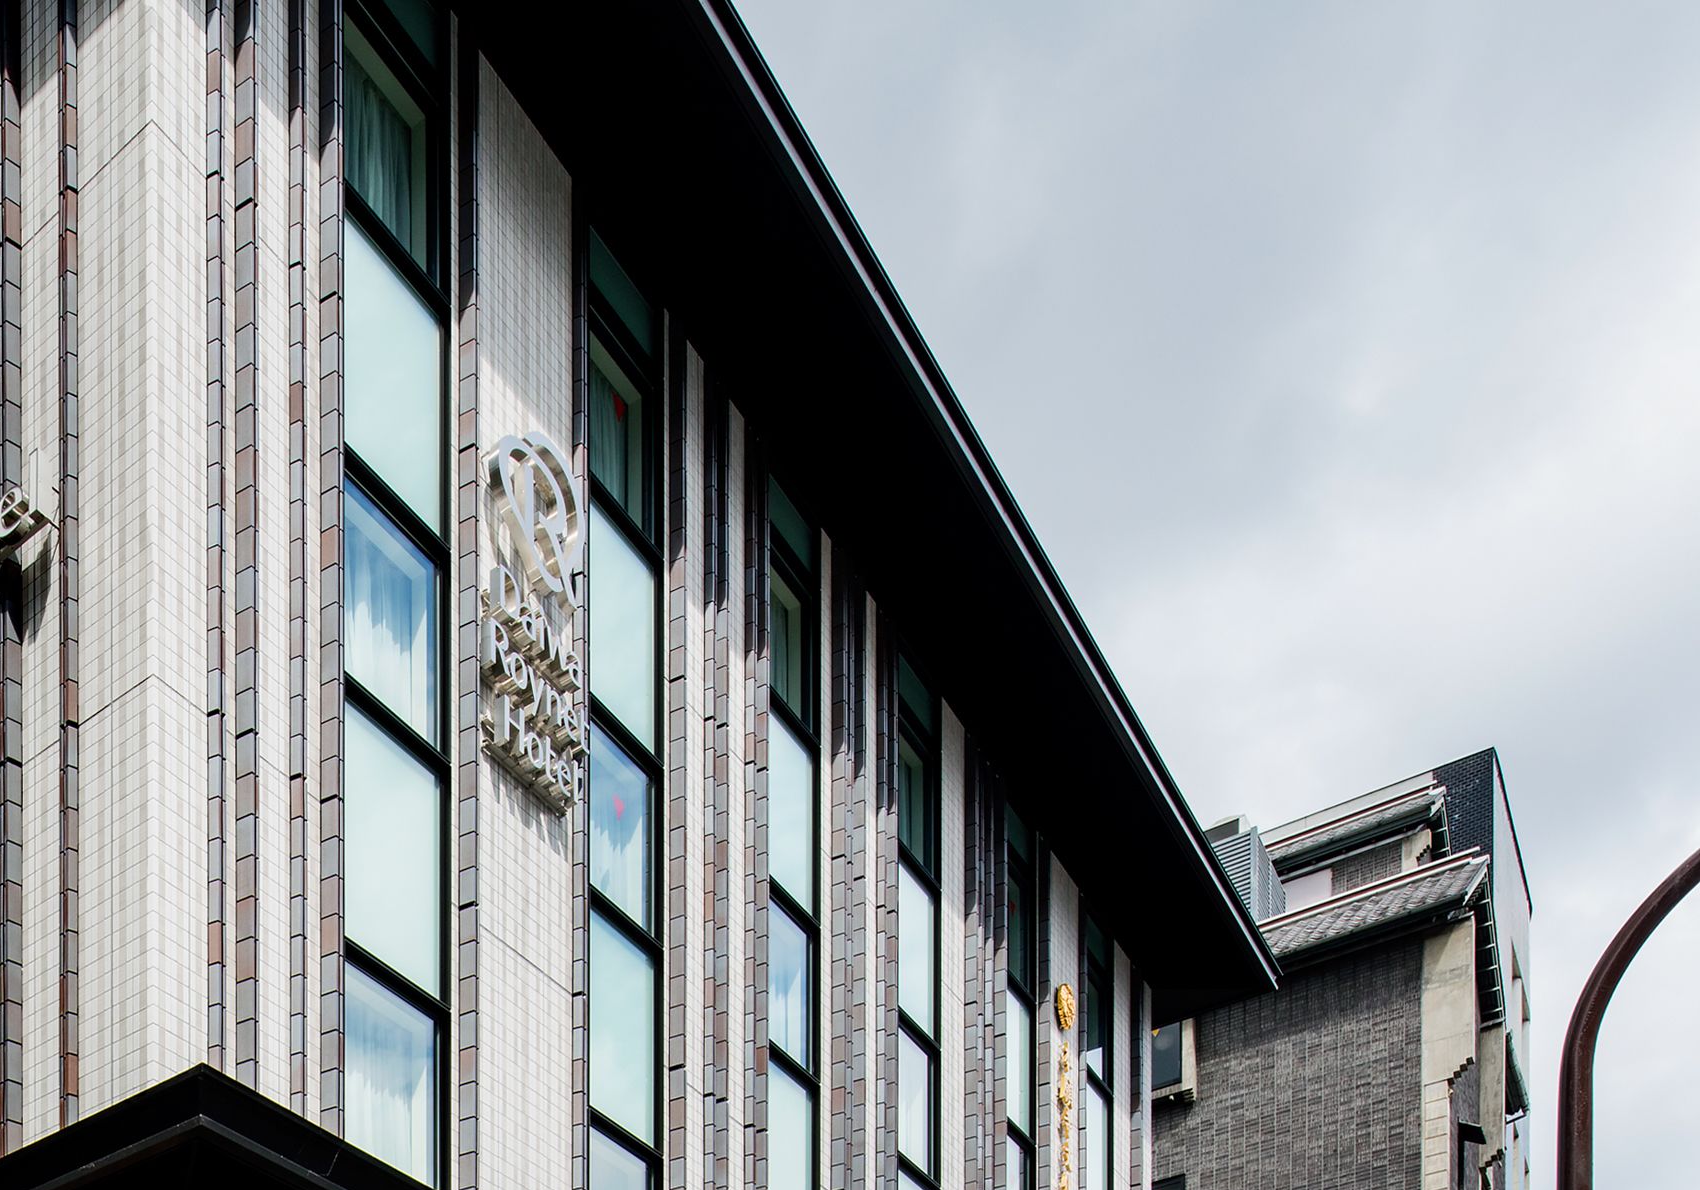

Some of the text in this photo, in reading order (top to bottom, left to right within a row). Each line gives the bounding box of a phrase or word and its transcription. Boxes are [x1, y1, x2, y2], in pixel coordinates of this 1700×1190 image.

[490, 619, 590, 754] Roynet
[498, 565, 582, 690] Daiwa
[503, 694, 579, 807] Hotel
